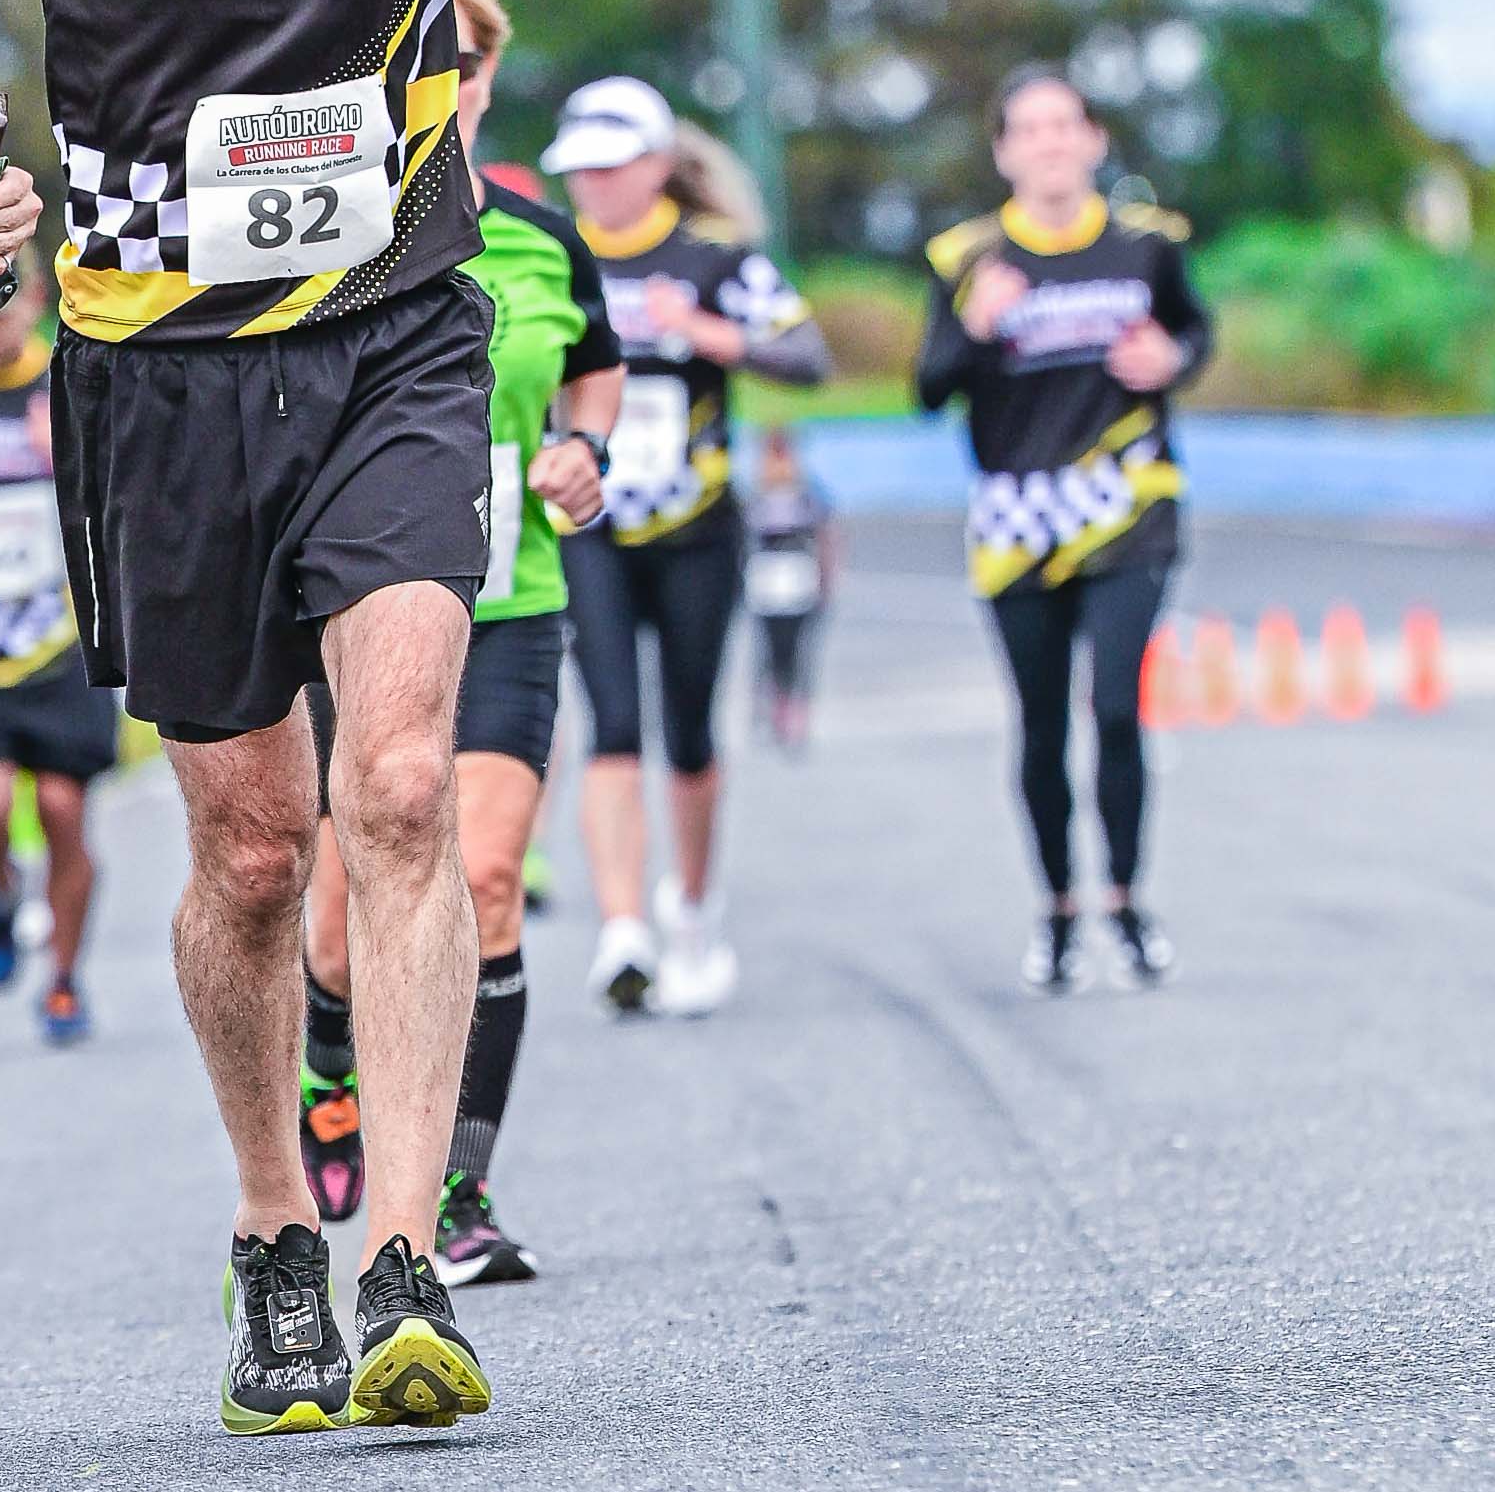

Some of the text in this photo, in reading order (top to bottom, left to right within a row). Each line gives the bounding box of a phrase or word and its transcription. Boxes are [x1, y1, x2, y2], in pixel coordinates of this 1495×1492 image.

[219, 103, 363, 147] AUTÓDROMO
[216, 154, 363, 177] La Carrera de los Clubes del Noroeste
[244, 138, 342, 163] RUNNING RACE
[246, 185, 341, 250] 82
